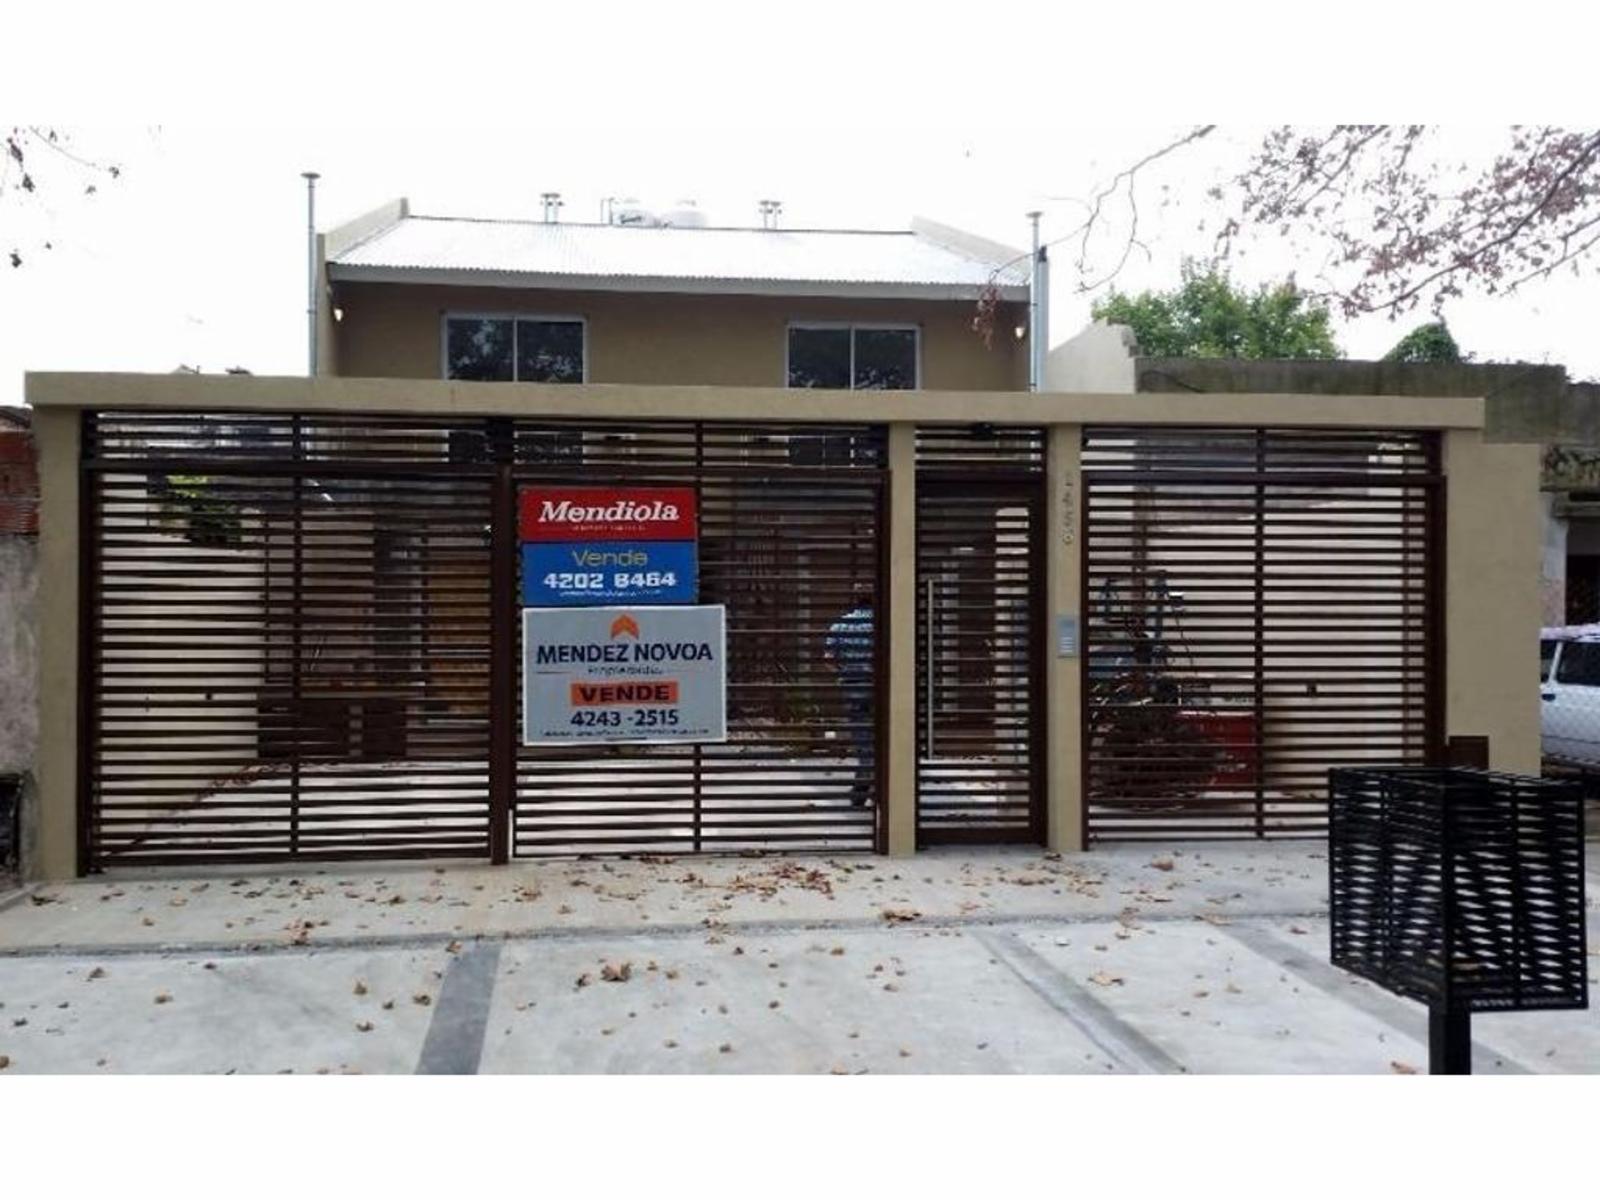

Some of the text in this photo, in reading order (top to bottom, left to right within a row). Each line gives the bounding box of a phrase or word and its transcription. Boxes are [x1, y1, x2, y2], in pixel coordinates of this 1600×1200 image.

[538, 500, 679, 522] Mendiola
[572, 550, 648, 567] Vende
[543, 573, 604, 589] 4202
[536, 643, 713, 664] MENDEZ NOVOA
[579, 685, 670, 702] VENDE
[571, 711, 621, 726] 4243
